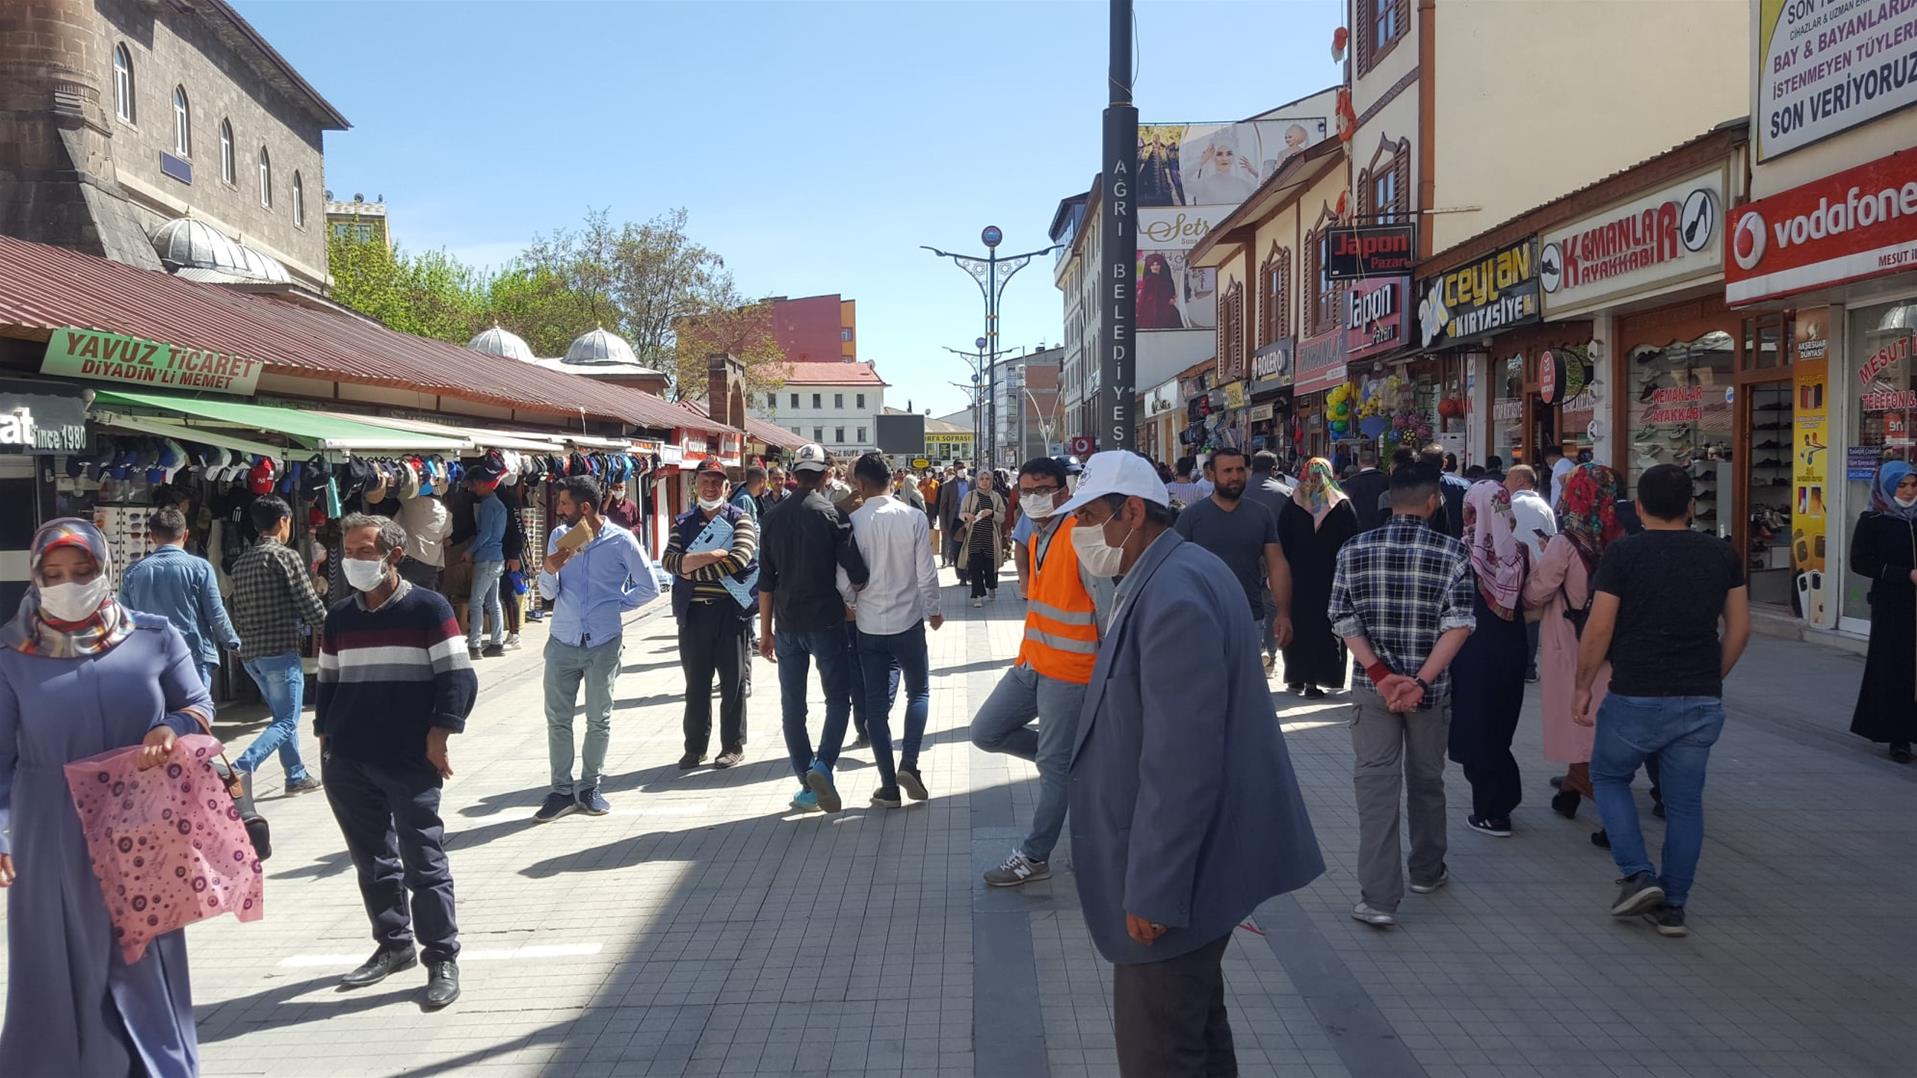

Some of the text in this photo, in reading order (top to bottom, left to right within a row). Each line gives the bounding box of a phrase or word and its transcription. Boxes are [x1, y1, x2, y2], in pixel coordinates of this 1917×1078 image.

[1773, 50, 1851, 100] İSTENMEYEN
[1774, 46, 1799, 74] BAY
[1804, 40, 1813, 59] &
[1771, 50, 1917, 139] SON VERİYORUZ
[1113, 159, 1127, 237] AĞRI
[1774, 181, 1917, 248] vodafone
[1334, 233, 1409, 259] Japon
[1562, 201, 1678, 288] KEMANLAR
[1878, 251, 1909, 267] MESUT
[1582, 245, 1654, 284] AYAKKABI
[1346, 283, 1392, 335] Japon
[1456, 295, 1523, 338] KIRTASİYE
[66, 331, 158, 366] YAVUZ
[1858, 336, 1908, 385] MESUT
[178, 371, 234, 390] MEMET
[1652, 385, 1703, 404] KEMANLAR
[1652, 407, 1703, 422] AYAKKABI
[1861, 391, 1906, 411] TELEFON
[62, 424, 87, 450] 1980
